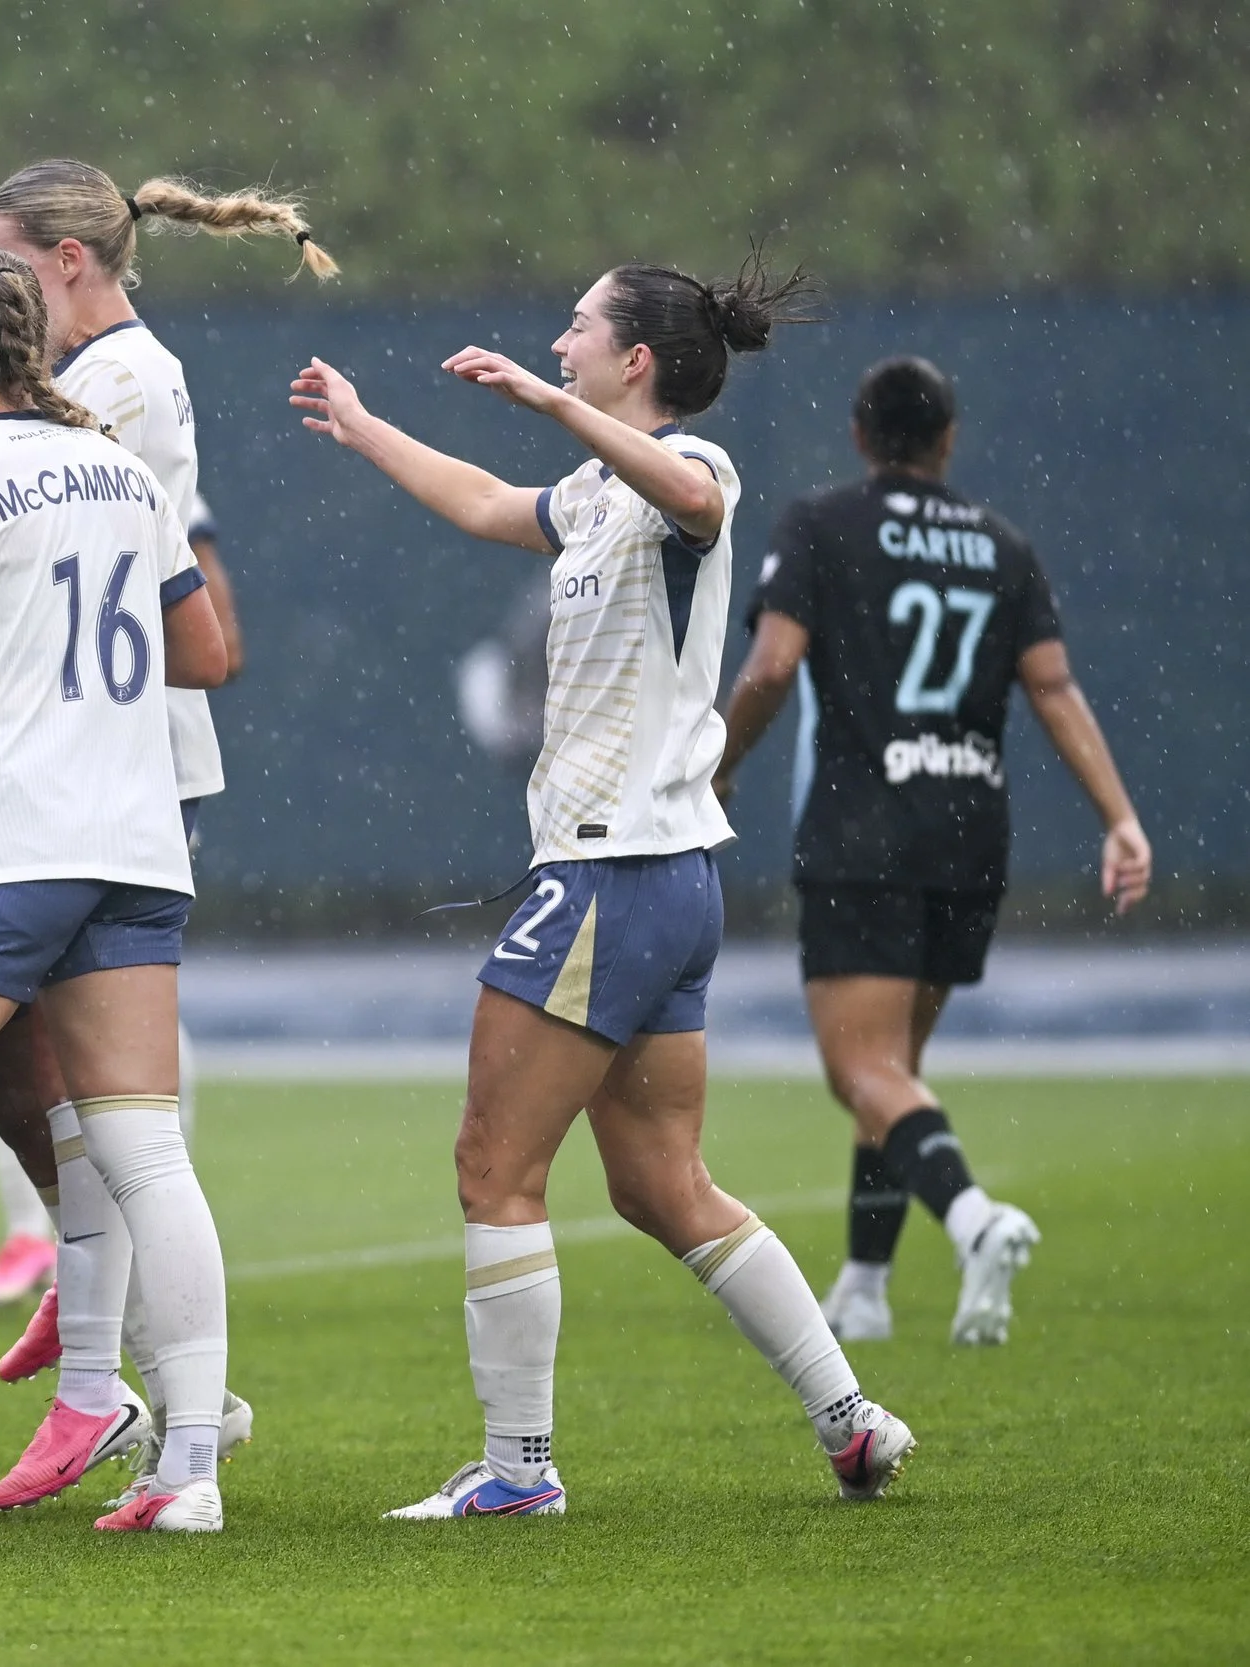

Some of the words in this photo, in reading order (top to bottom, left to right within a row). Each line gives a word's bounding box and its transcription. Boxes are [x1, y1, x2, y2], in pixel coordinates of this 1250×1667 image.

[878, 520, 997, 571] CARTER
[52, 552, 150, 705] 16
[889, 581, 996, 715] 27
[510, 879, 565, 952] 2
